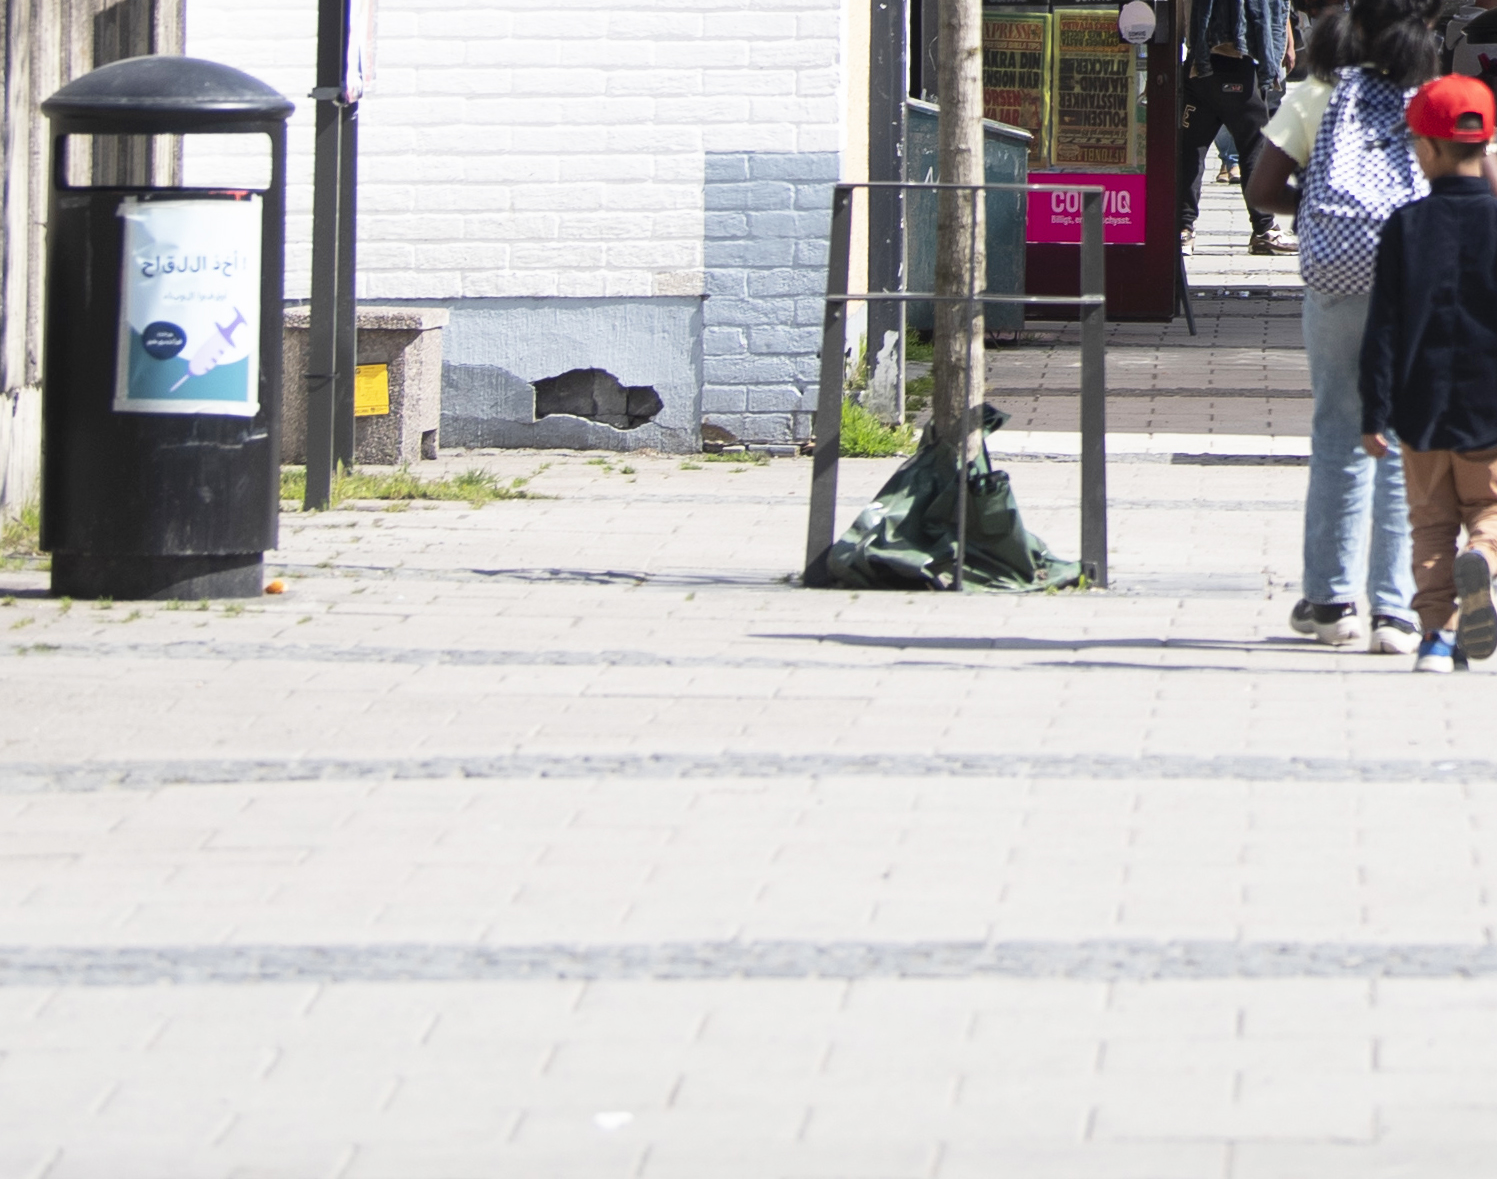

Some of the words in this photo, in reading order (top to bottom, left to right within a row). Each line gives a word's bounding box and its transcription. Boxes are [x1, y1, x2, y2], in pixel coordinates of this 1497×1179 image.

[983, 50, 1016, 69] ÄKRA
[1020, 51, 1041, 69] DIN
[1075, 59, 1128, 76] ATTACKER
[983, 70, 1016, 88] NSION
[984, 89, 1021, 107] ÖRSEN
[1060, 93, 1127, 110] MISSTÄNKER
[1083, 112, 1127, 127] POLISEN
[1059, 148, 1125, 163] AFTONBLA
[1051, 190, 1132, 213] COIQ
